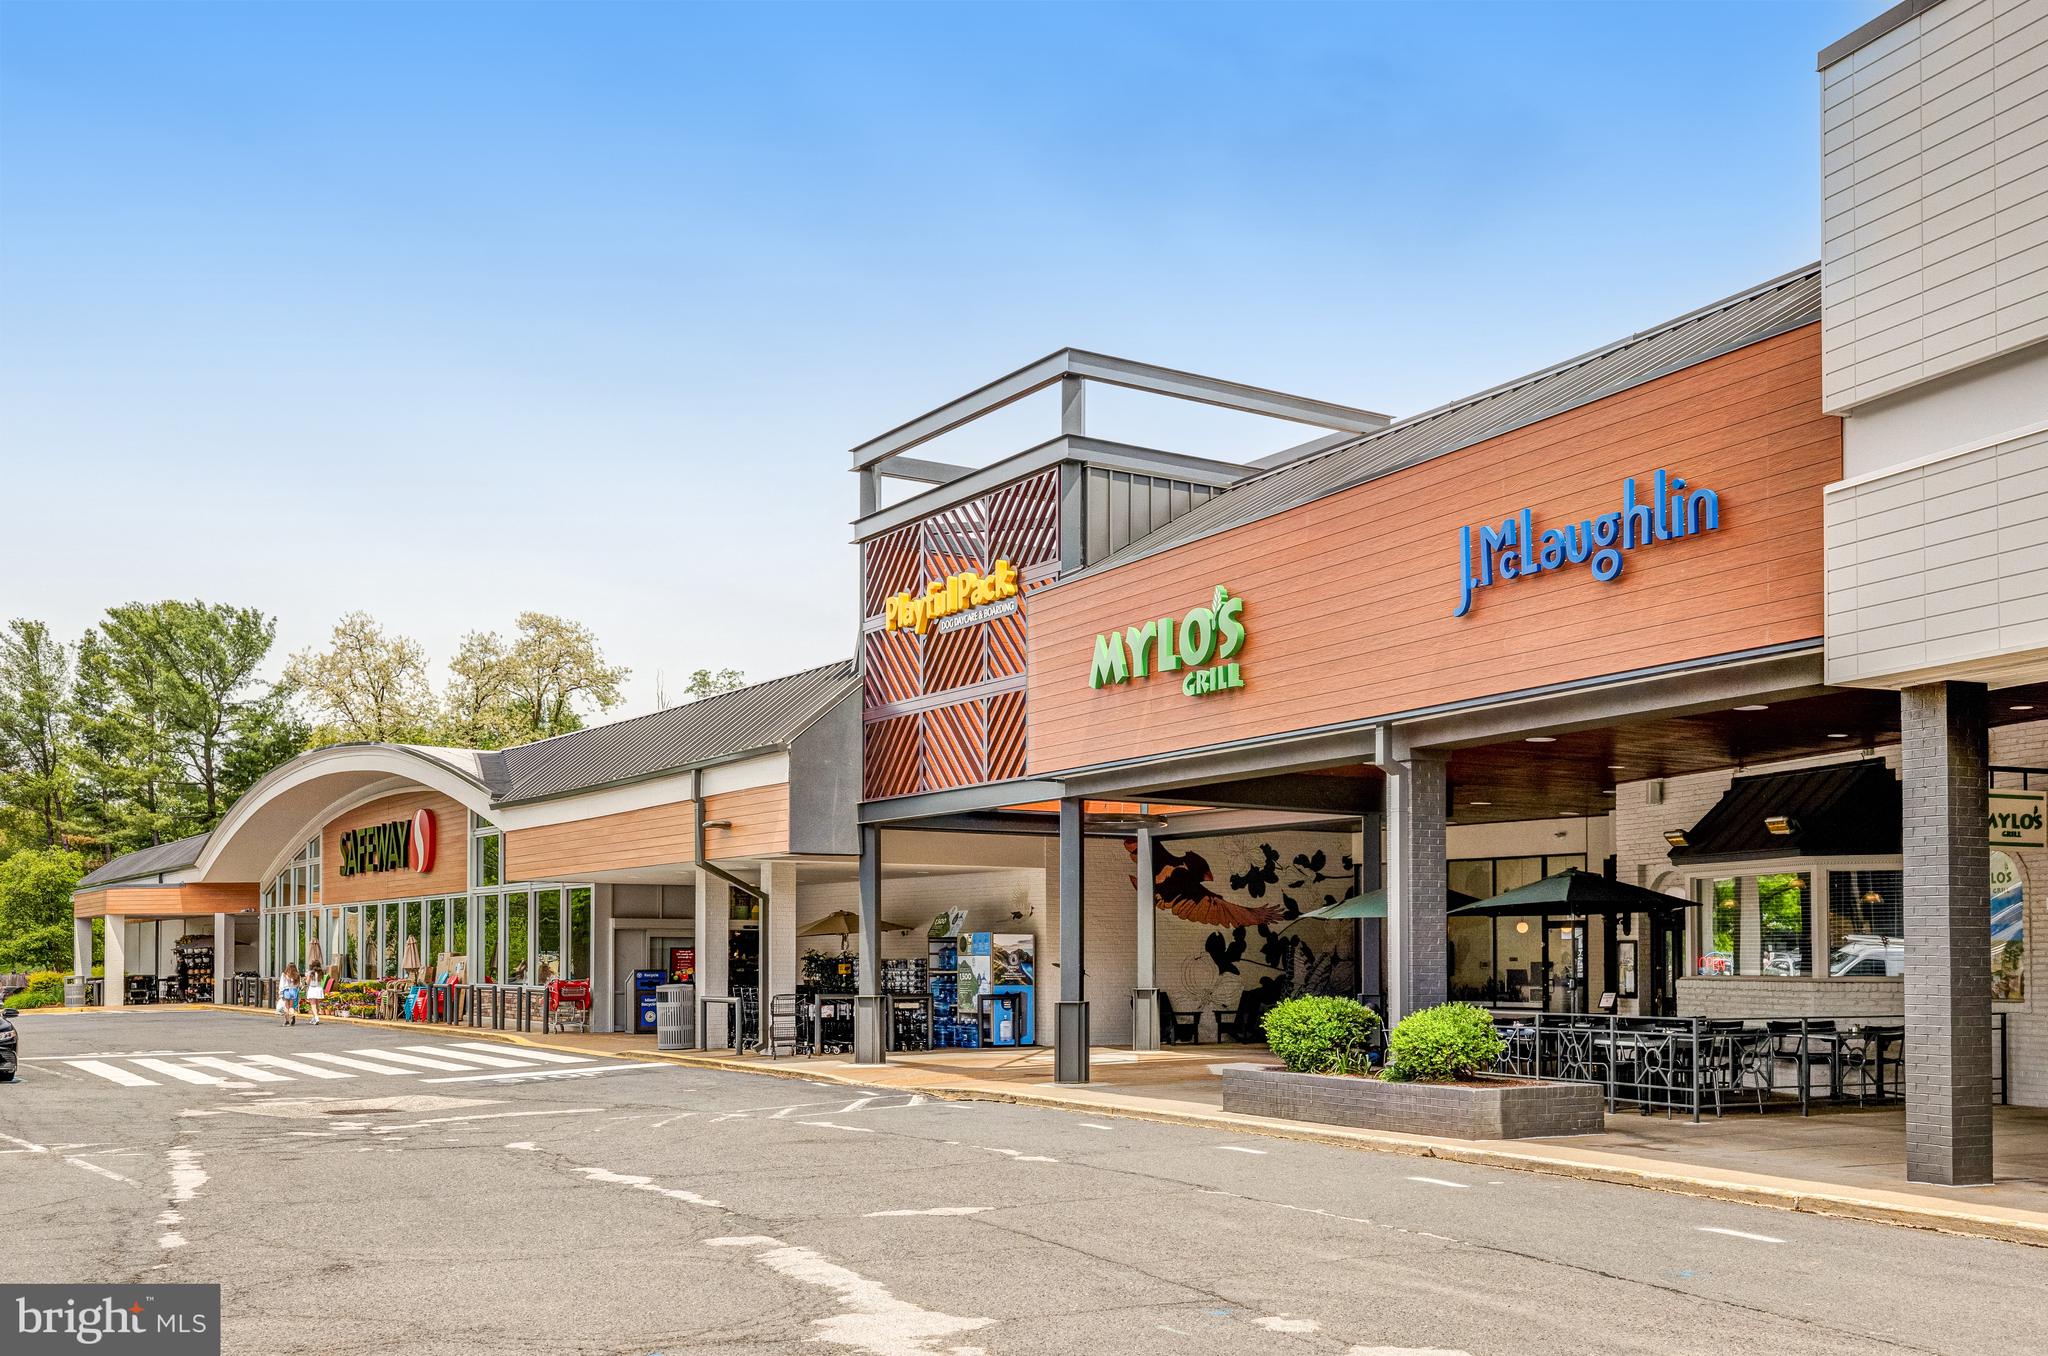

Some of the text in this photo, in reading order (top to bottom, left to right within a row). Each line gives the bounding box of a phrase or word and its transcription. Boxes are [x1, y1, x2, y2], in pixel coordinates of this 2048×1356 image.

[1480, 469, 1719, 581] McLaughlin
[941, 601, 1015, 631] DOG DAYCARE & BOARDING
[1088, 585, 1245, 689] MYLO'S
[1183, 663, 1245, 697] GRILL
[340, 819, 412, 877] SAFEWAY
[2002, 830, 2022, 838] GRILL
